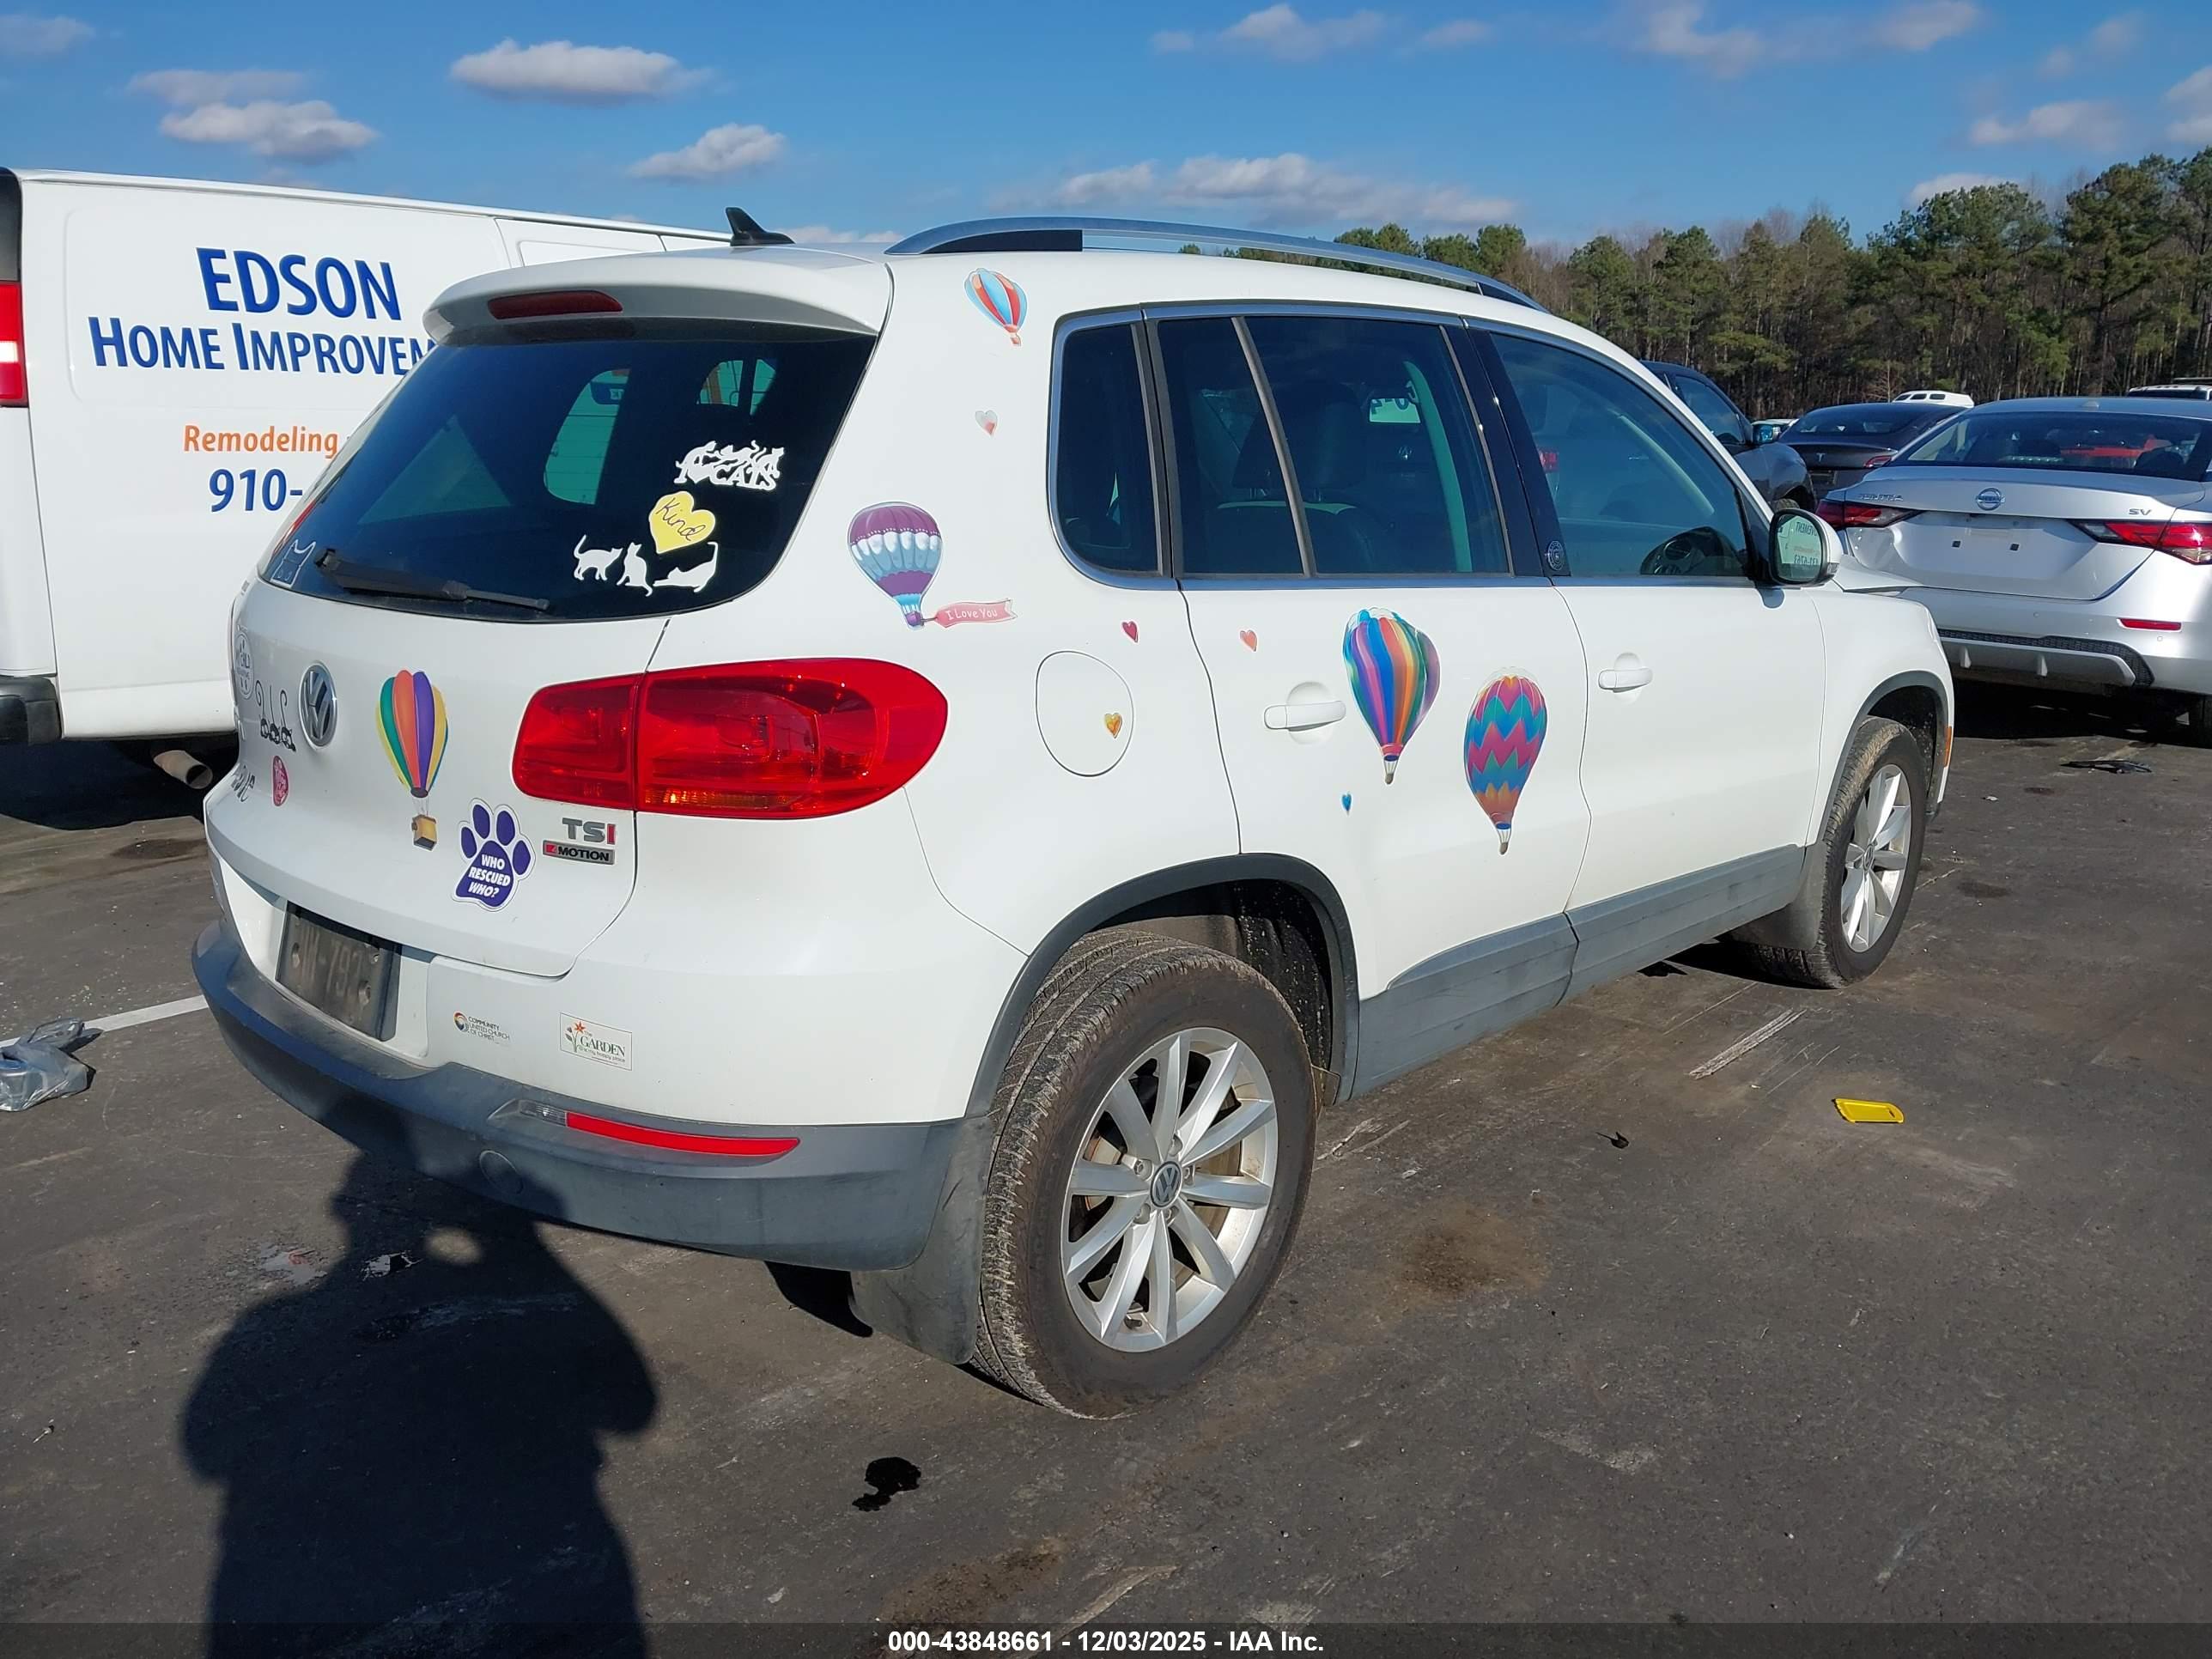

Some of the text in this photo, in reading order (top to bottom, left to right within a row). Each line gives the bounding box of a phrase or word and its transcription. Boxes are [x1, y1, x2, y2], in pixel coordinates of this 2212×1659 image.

[196, 247, 403, 321] EDSON
[88, 317, 225, 370] HOME
[184, 425, 337, 459] Remodeling
[209, 469, 303, 513] 910-
[656, 497, 706, 541] Kind
[945, 607, 998, 620] I Love You
[562, 817, 616, 845] TSI
[482, 854, 506, 871] WHO
[468, 867, 511, 886] RESCUED
[468, 882, 500, 898] WHO?
[468, 1016, 500, 1030] COMMUNITY
[469, 1024, 510, 1040] UNITED CHURCH
[580, 1036, 626, 1057] GARDEN
